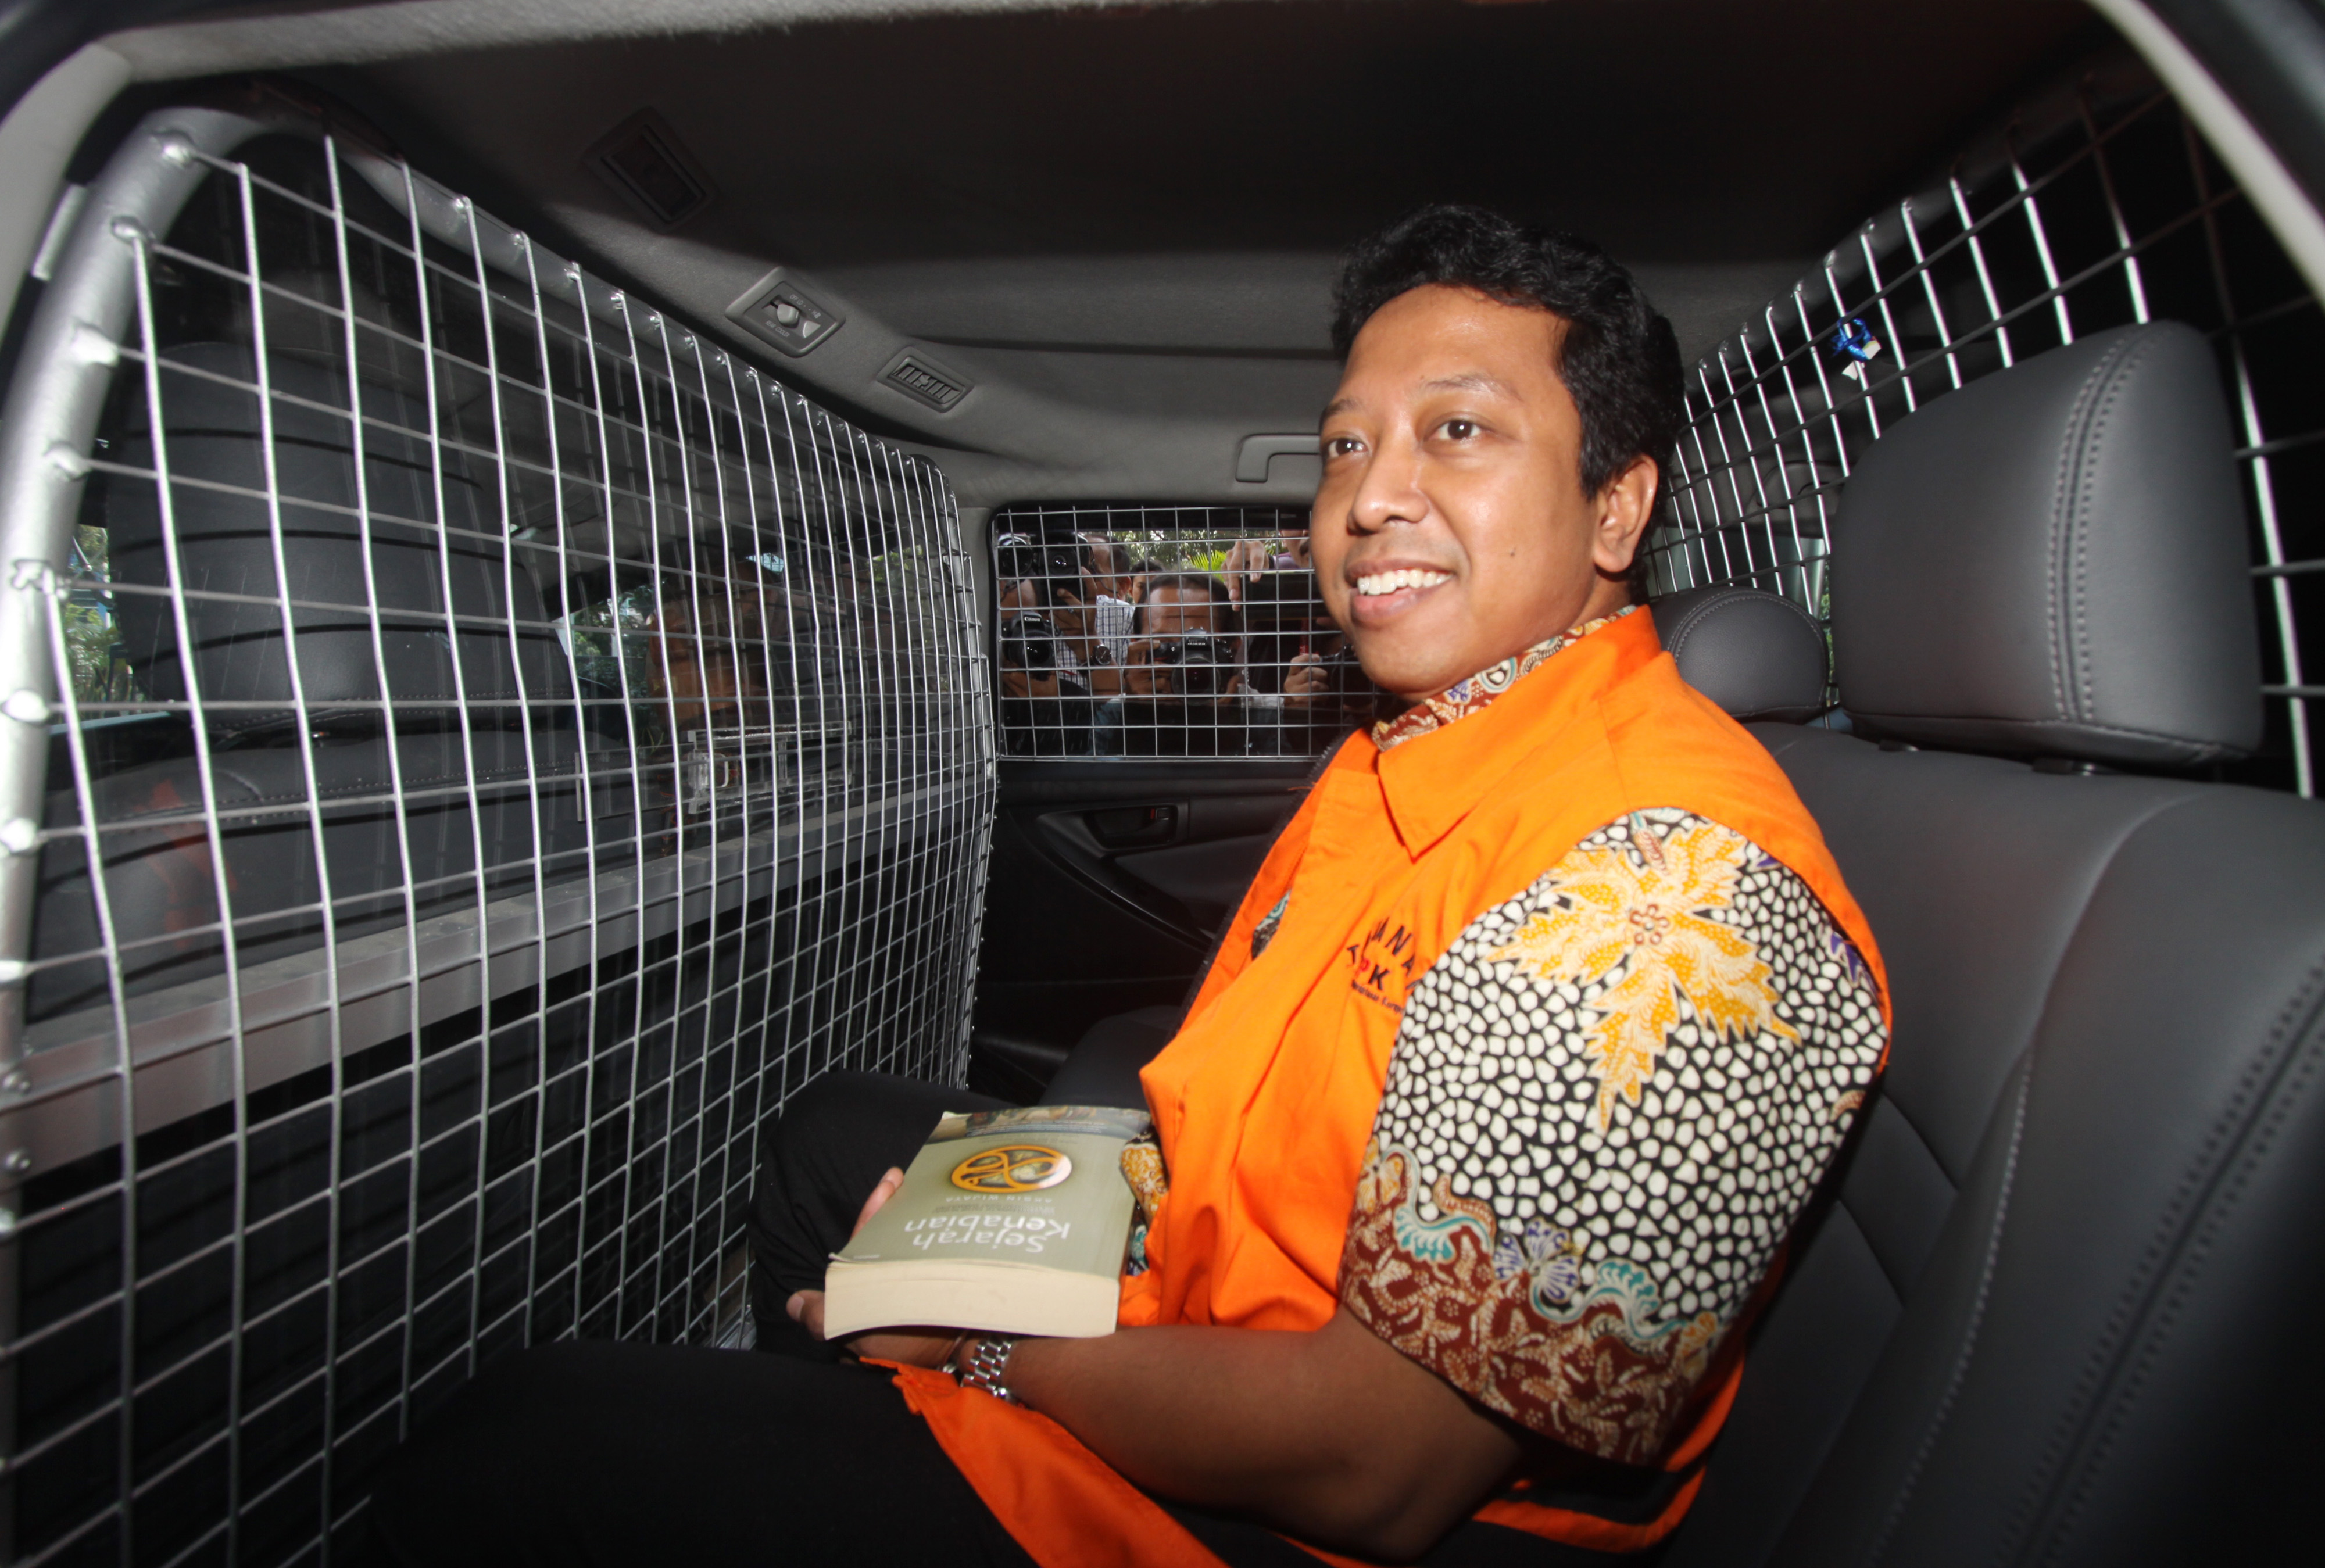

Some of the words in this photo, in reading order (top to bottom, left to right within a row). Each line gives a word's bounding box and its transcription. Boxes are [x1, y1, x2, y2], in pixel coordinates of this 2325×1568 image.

[775, 327, 790, 337] COOLER
[904, 1215, 1071, 1240] Kenabian
[913, 1228, 1047, 1253] Sejarah
